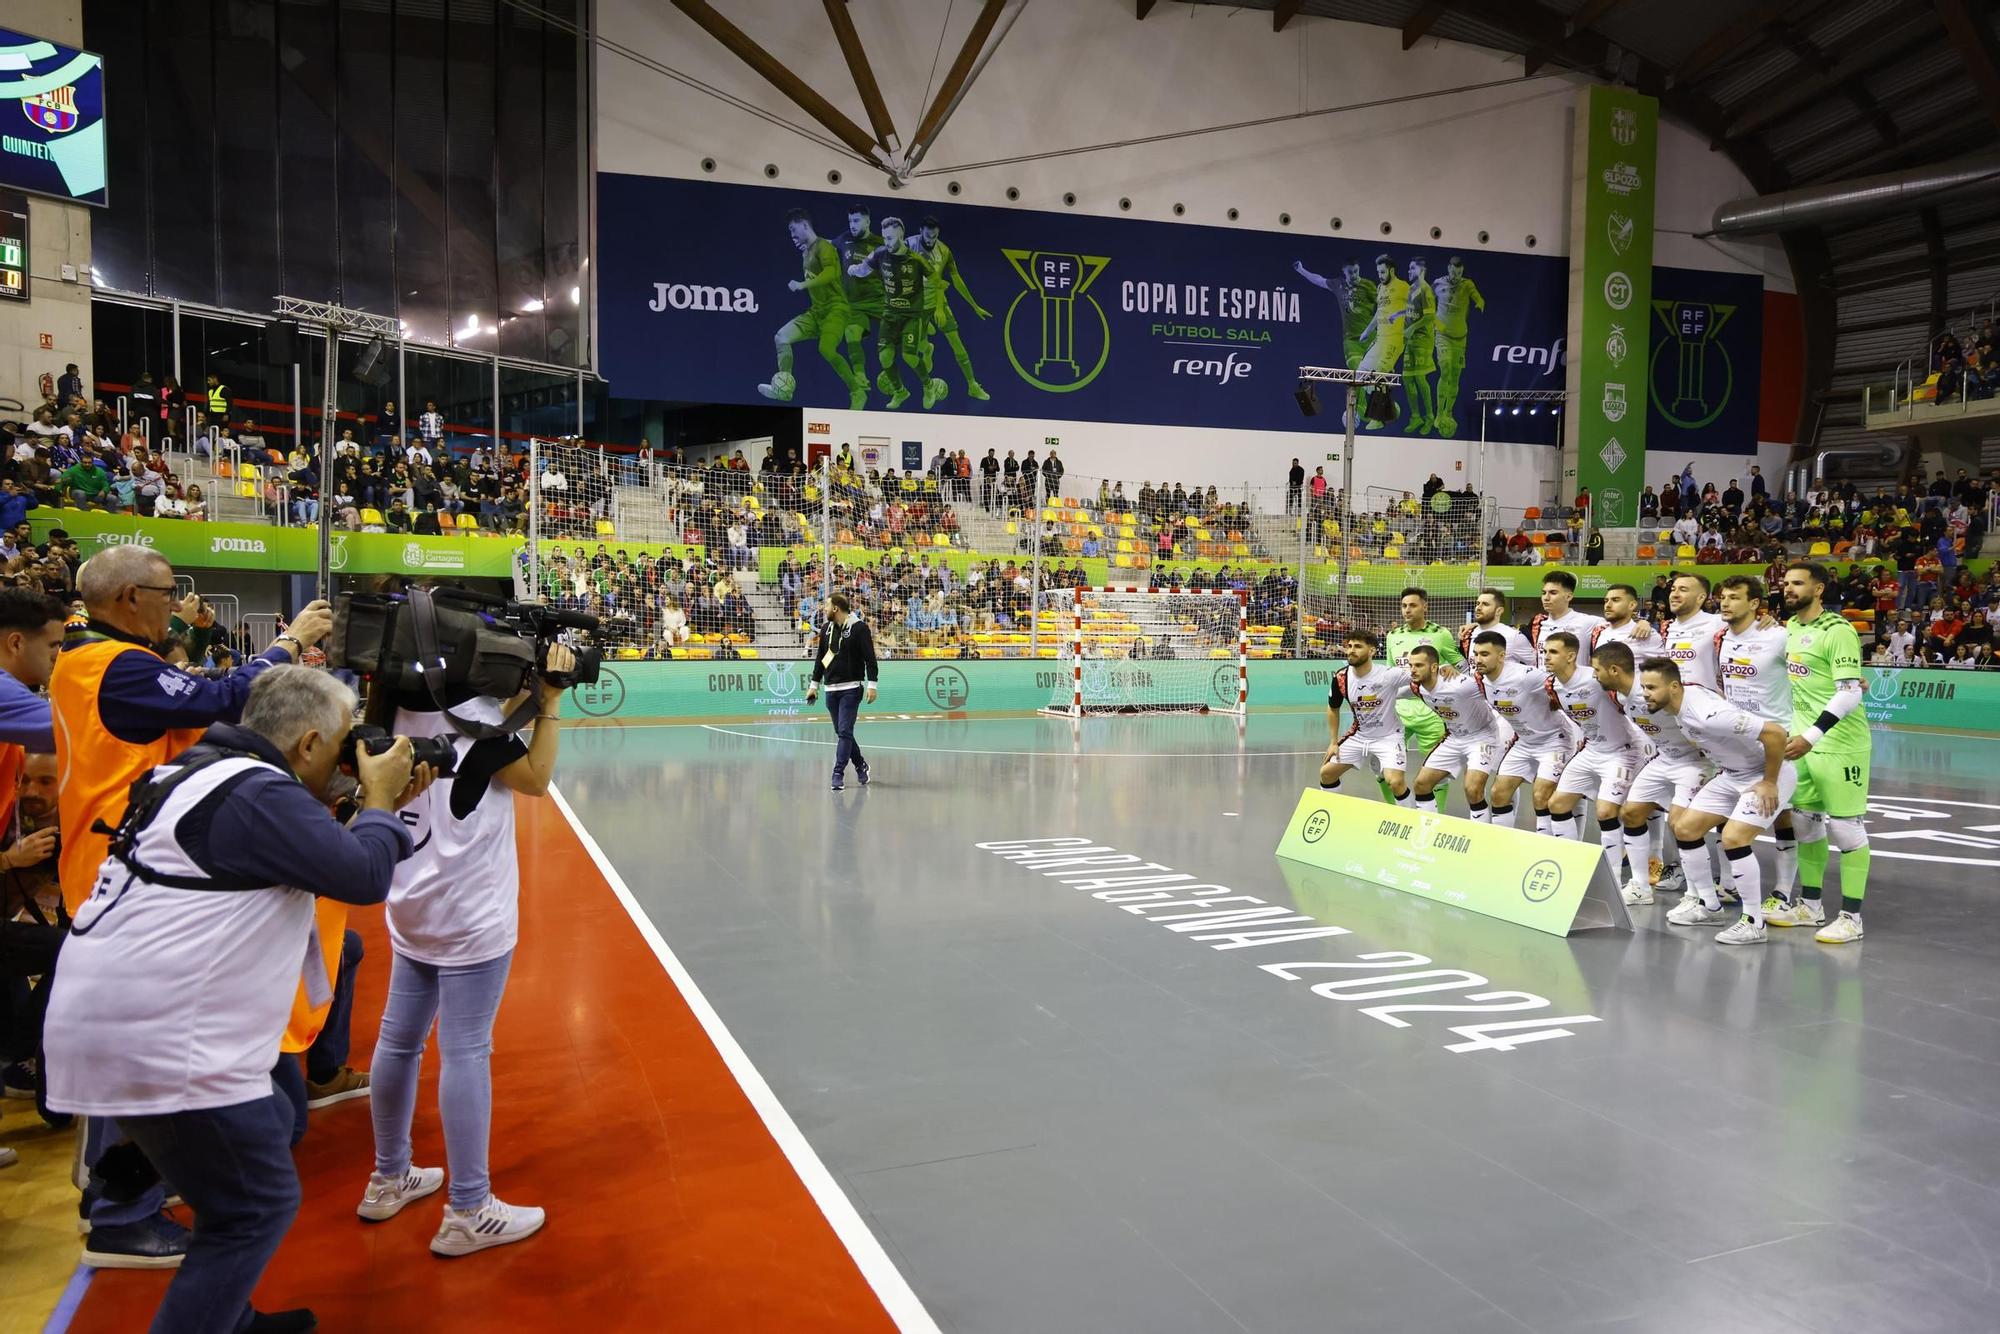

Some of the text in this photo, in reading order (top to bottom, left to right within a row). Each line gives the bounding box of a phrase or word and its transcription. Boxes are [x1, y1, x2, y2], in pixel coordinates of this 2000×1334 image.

[39, 98, 61, 109] FCB
[0, 237, 21, 246] ANTE
[1609, 285, 1627, 299] CT
[1122, 280, 1301, 323] COPA DE ESPAÑA
[1152, 322, 1272, 343] FÚTBOL SALA
[1172, 352, 1252, 385] renfe
[96, 529, 154, 547] renfe
[1835, 656, 1858, 665] UCAM
[709, 674, 764, 692] COPA DE
[1304, 671, 1330, 686] COPA
[1900, 680, 1956, 700] ESPAÑA
[754, 697, 787, 705] FÚTBOL
[768, 706, 800, 717] renfe
[1843, 765, 1861, 782] 19
[1378, 820, 1471, 854] COPA DE ESPAÑA
[974, 837, 1353, 951] CARTAGENA
[1257, 951, 1604, 1054] 2024
